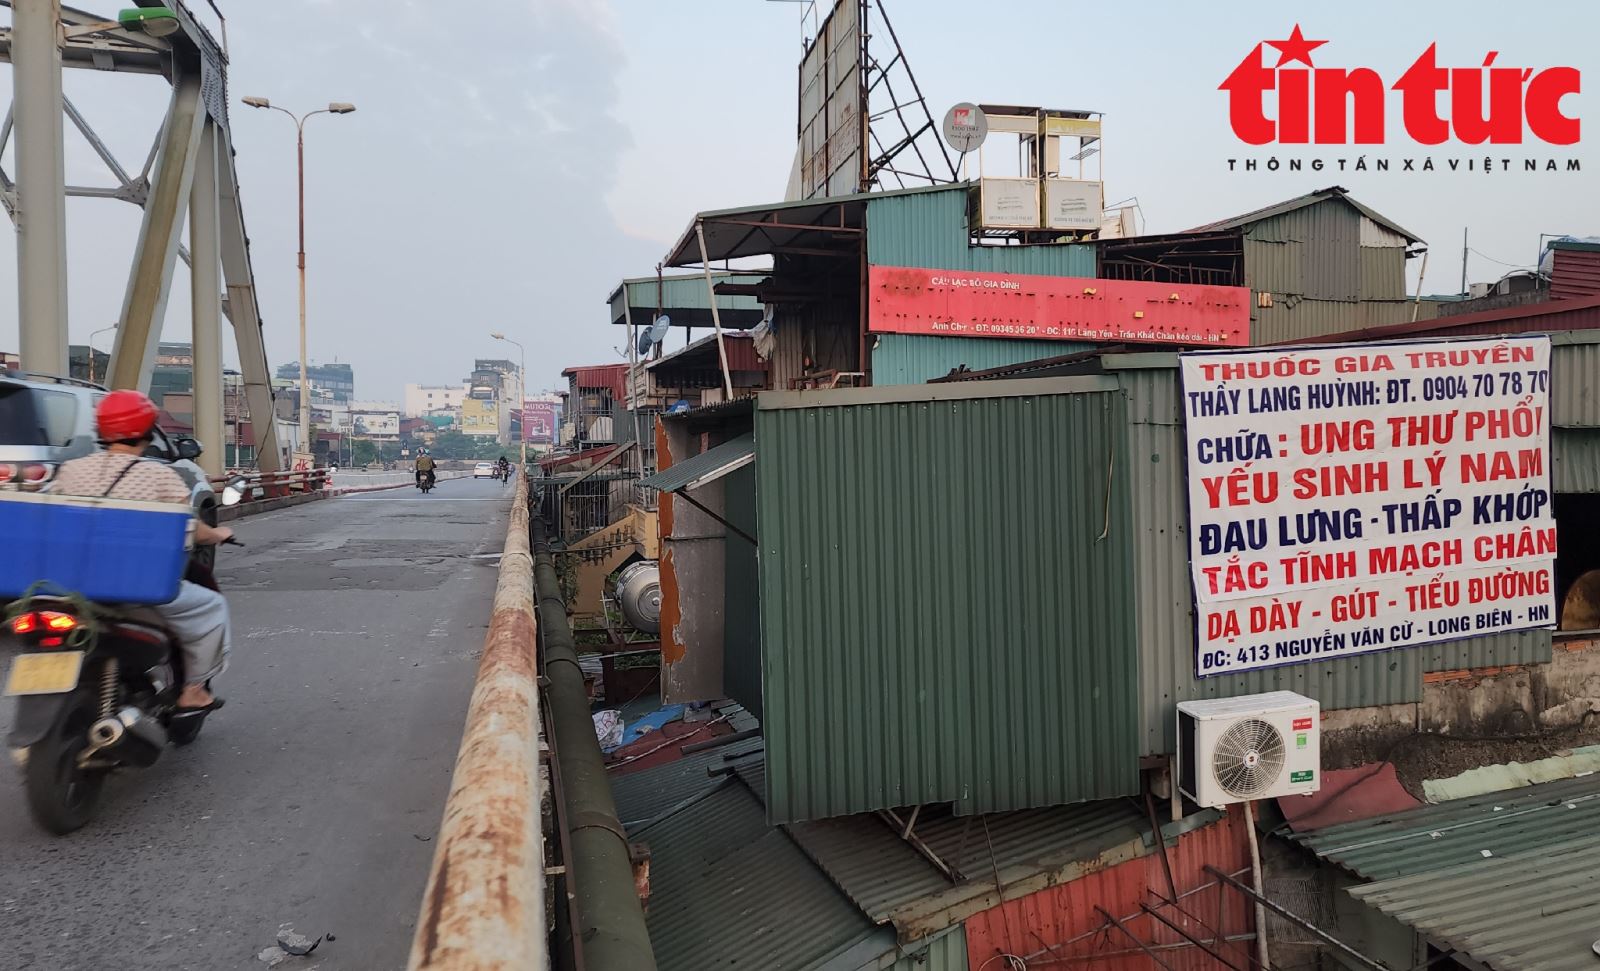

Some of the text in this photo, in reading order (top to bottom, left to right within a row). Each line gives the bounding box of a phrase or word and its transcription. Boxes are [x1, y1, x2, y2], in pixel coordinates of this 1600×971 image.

[983, 280, 998, 288] GIA
[932, 322, 949, 331] Anh
[975, 323, 989, 332] ĐT:
[1047, 326, 1061, 335] ĐC:
[1199, 341, 1534, 382] THUỐC GIA TRUYỀN
[1188, 369, 1548, 418] THẦY LANG HUỲNH: ĐT. 0904 70 78 70
[1300, 419, 1375, 456] UNG
[1387, 409, 1459, 447] THƯ
[1465, 395, 1543, 442] PHỔI
[1201, 448, 1543, 509] YẾU SINH LÝ NAM
[1199, 518, 1268, 556] ĐAU
[1278, 508, 1363, 547] LƯNG
[1382, 488, 1462, 535] THẤP
[1473, 482, 1548, 525] KHỚP
[1202, 526, 1556, 595] TẮC TĨNH MẠCH CHÂN
[1207, 609, 1241, 643] DẠ
[1250, 598, 1303, 634] DÀY
[1331, 587, 1380, 623] GÚT
[1405, 572, 1460, 612] TIỂU
[1468, 566, 1550, 604] ĐƯỜNG
[1203, 650, 1231, 670] ĐC:
[1237, 644, 1270, 663] 413
[1275, 629, 1346, 659] NGUYỄN
[1351, 626, 1384, 648] VĂN
[1390, 620, 1414, 642] CỪ
[1428, 616, 1471, 637] LONG
[1476, 608, 1512, 630] BIÊN
[1528, 604, 1549, 622] HN
